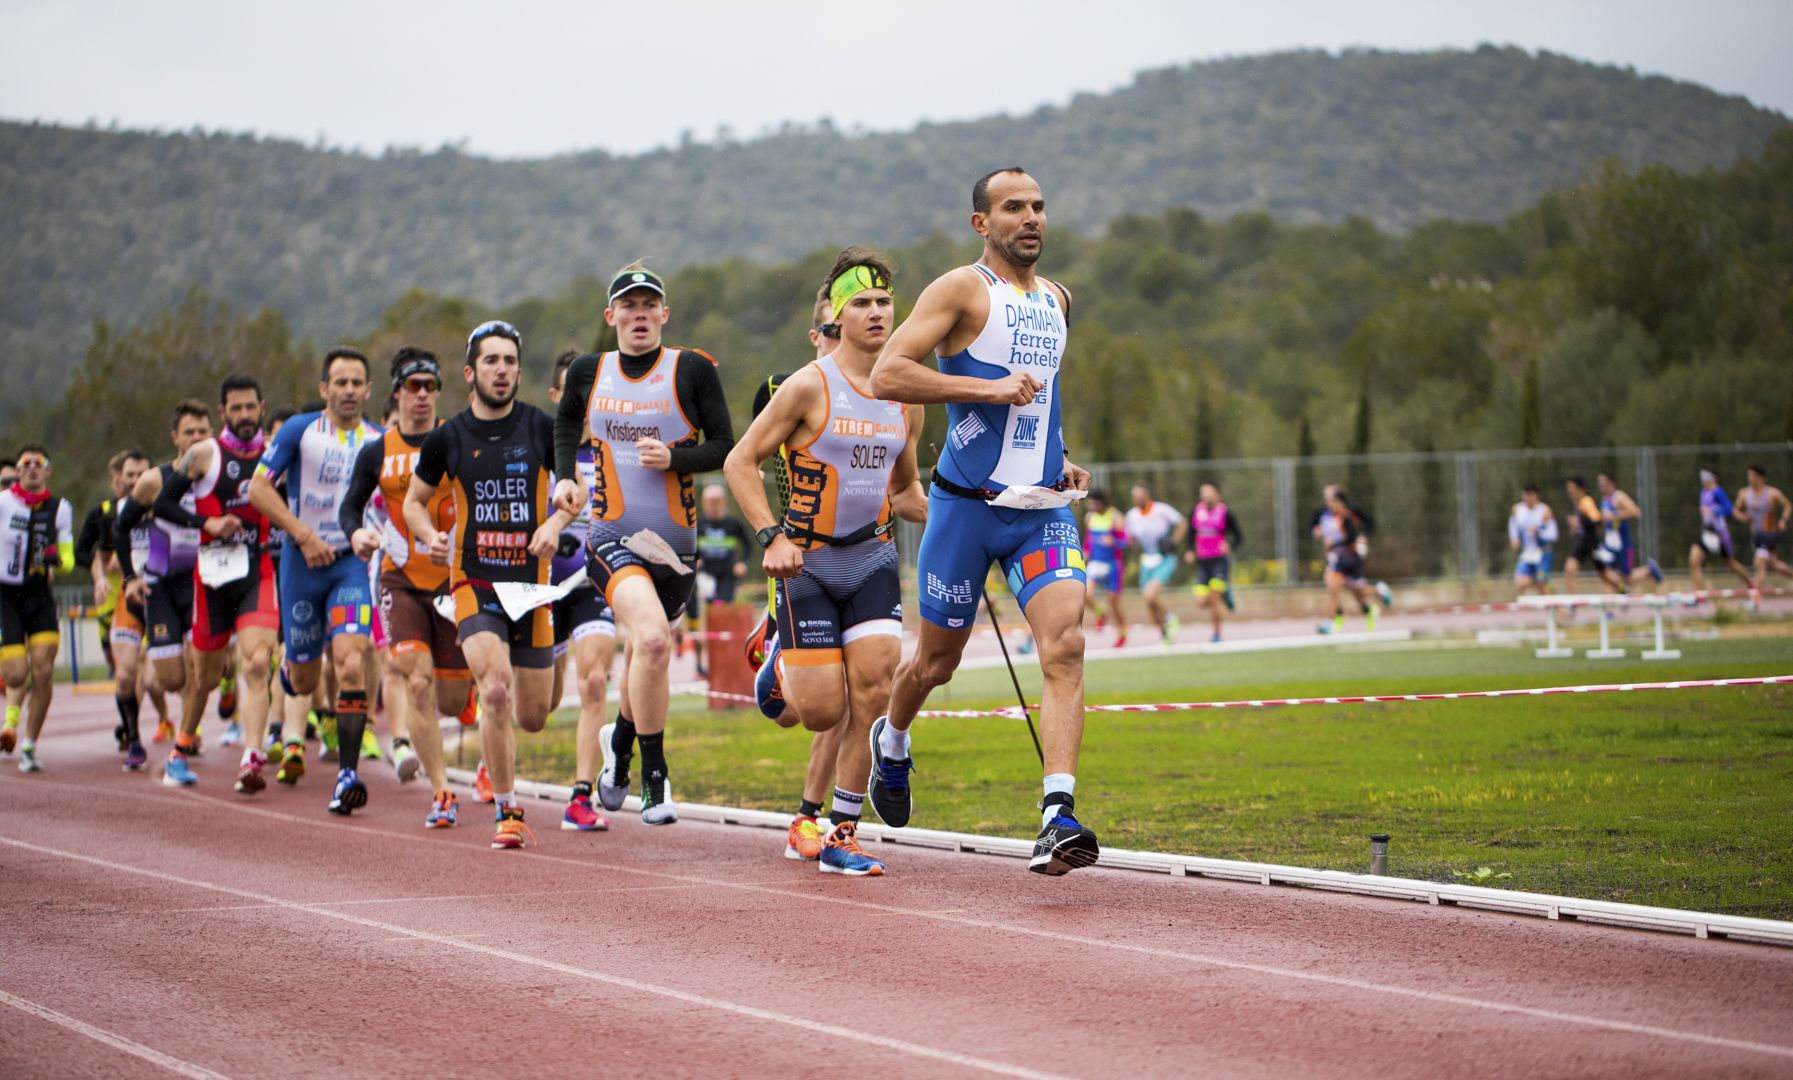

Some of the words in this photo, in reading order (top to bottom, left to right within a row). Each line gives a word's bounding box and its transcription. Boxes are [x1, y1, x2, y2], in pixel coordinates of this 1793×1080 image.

[1012, 329, 1058, 350] ferrer
[1008, 347, 1058, 368] hotels
[833, 418, 874, 437] XTREM
[1013, 417, 1040, 441] ZUNE
[850, 444, 887, 469] SOLER
[474, 478, 528, 501] SOLER
[475, 502, 529, 523] OXIGEN
[477, 532, 527, 547] XTREM
[802, 636, 822, 644] NOVO
